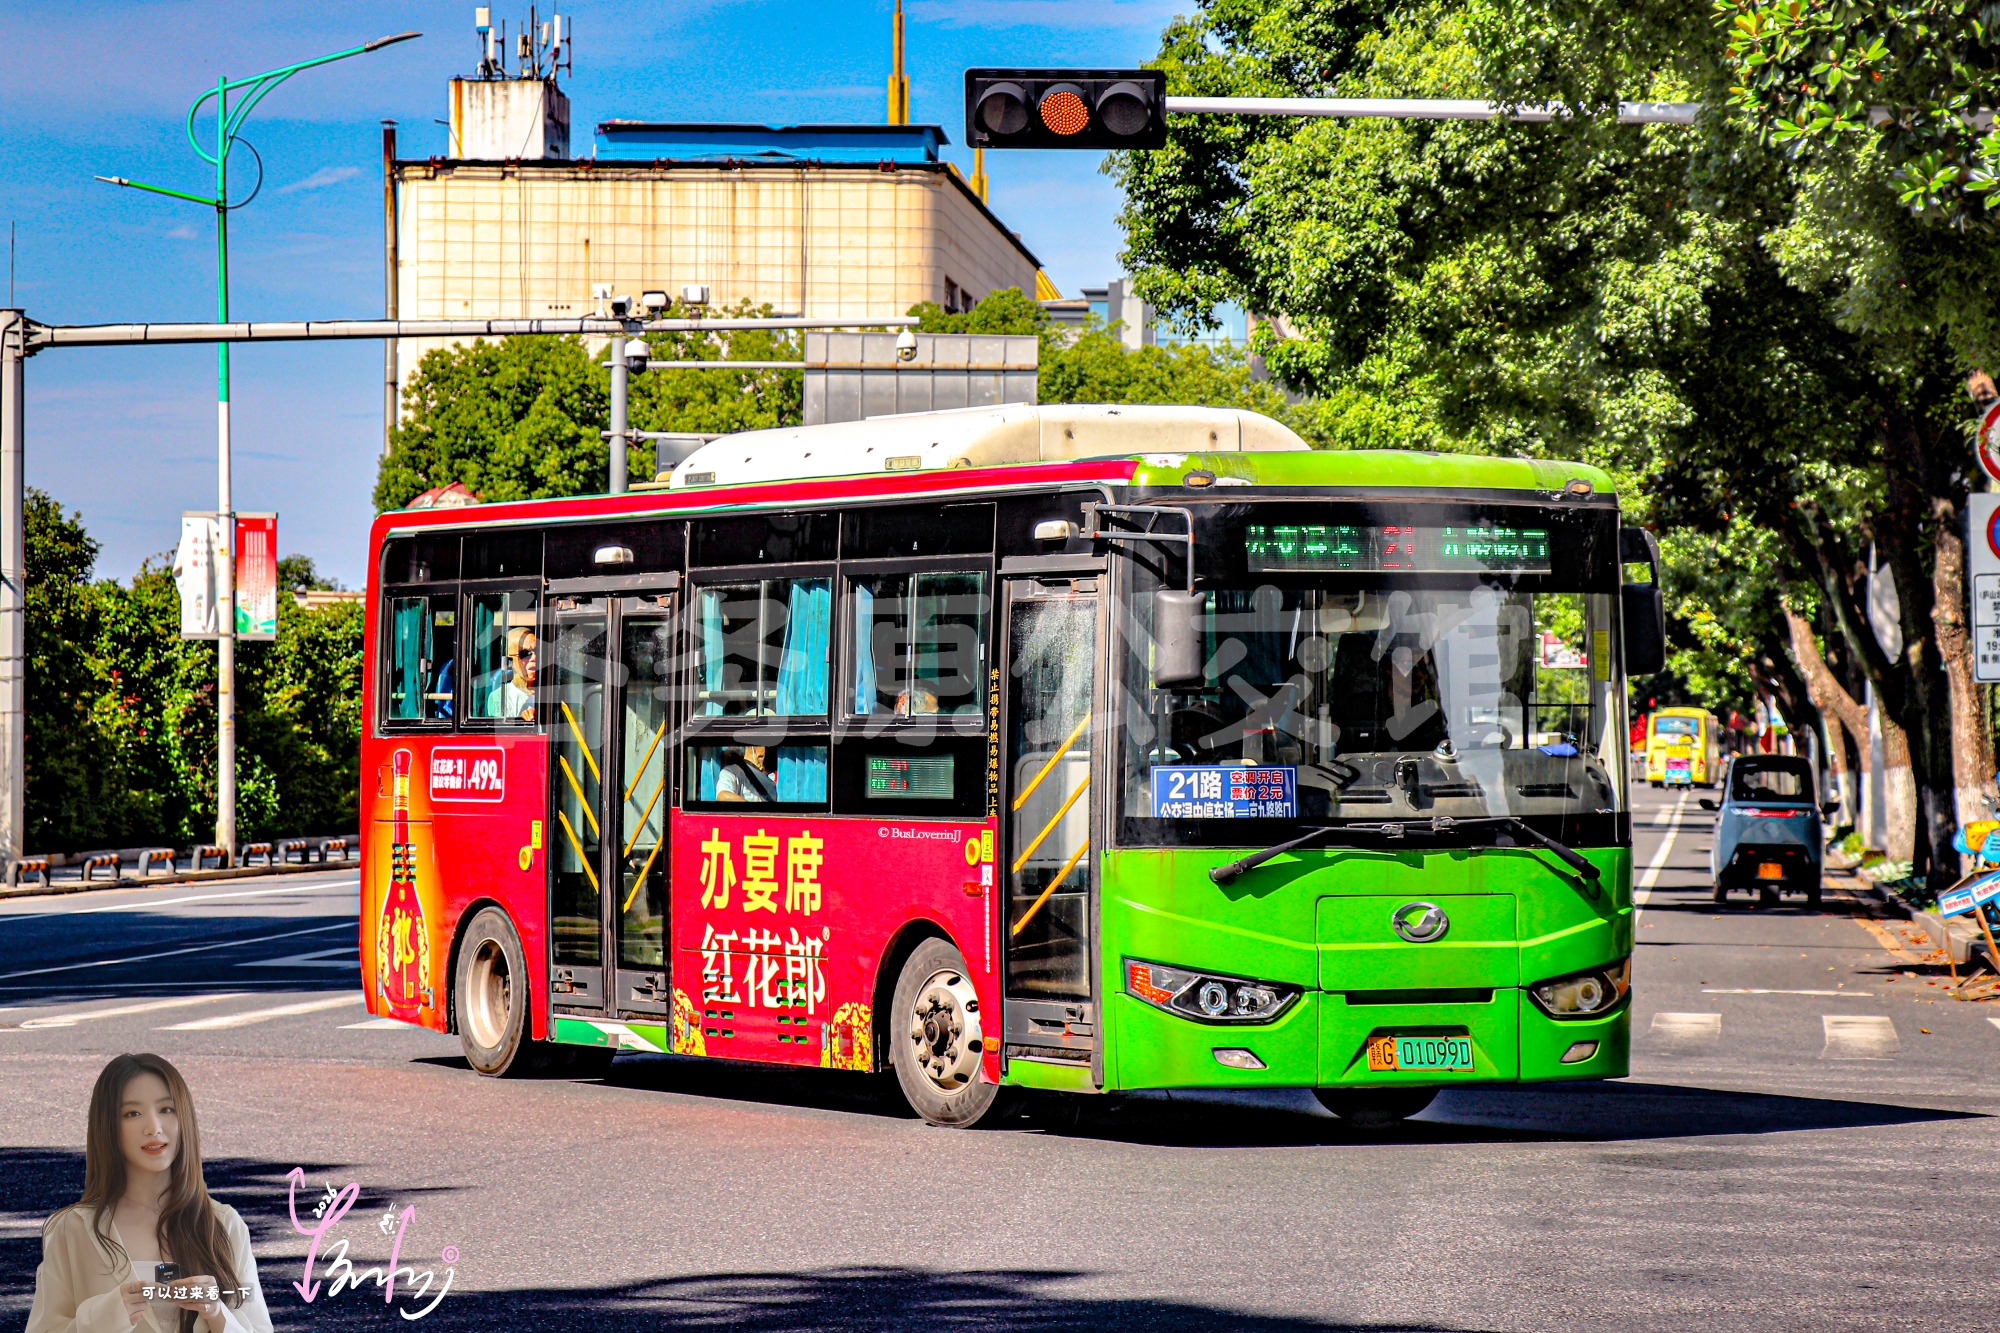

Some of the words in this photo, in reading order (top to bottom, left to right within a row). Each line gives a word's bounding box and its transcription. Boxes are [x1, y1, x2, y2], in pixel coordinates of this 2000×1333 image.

[1168, 771, 1222, 799] 21路
[1230, 770, 1283, 785] 空调开启
[1230, 786, 1283, 801] 票价2元
[699, 827, 824, 917] 办宴席
[701, 922, 826, 1015] 红花郎
